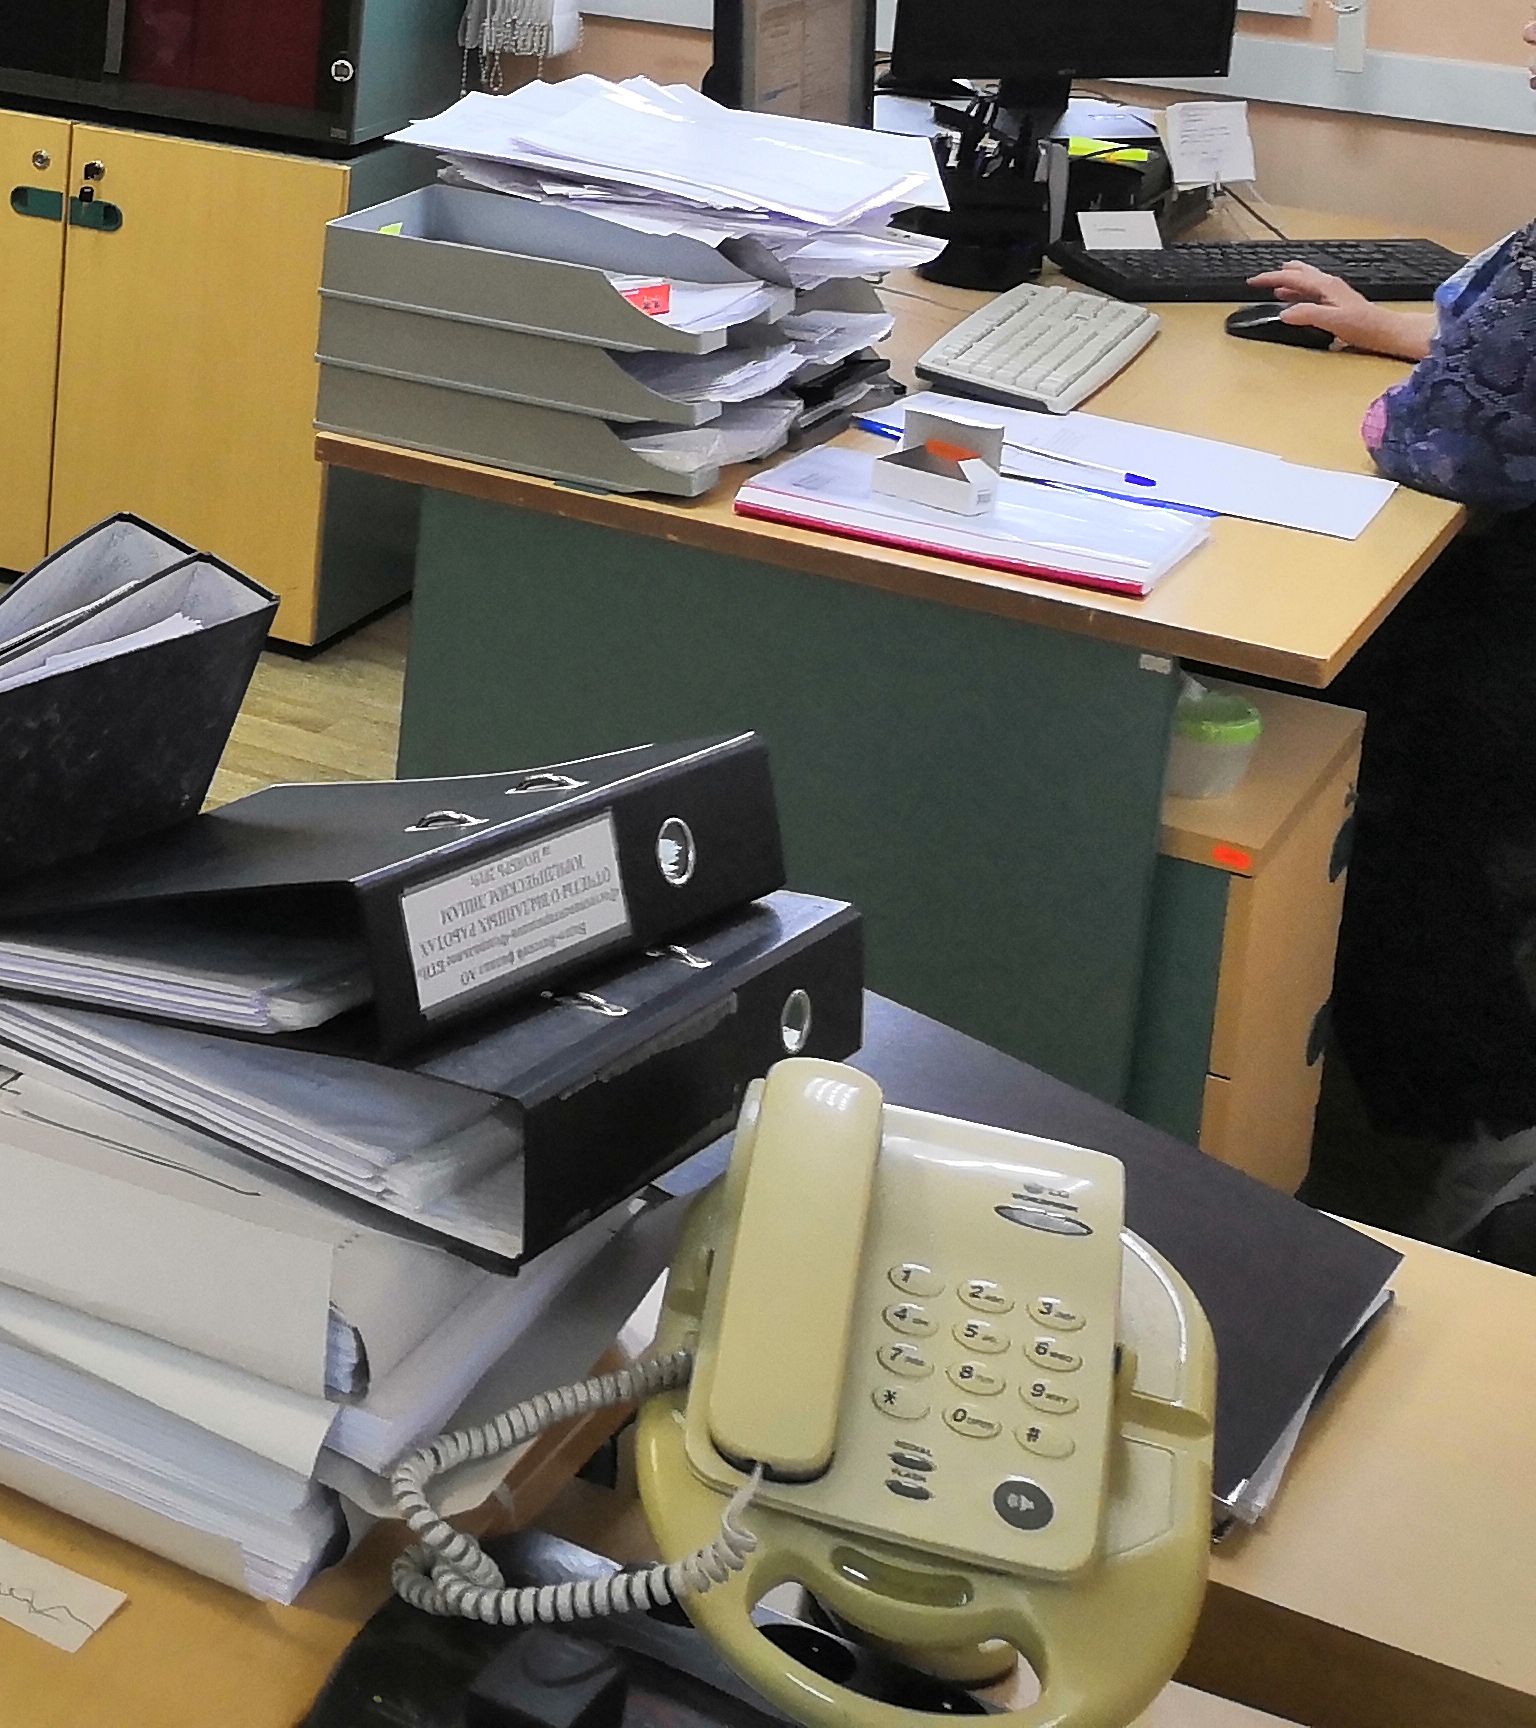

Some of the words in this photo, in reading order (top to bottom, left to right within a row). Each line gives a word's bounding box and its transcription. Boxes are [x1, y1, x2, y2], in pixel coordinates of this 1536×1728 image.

[488, 853, 585, 905] ЮРИДИЧЕСКИМ
[438, 891, 488, 925] ЛИЦАМ
[477, 891, 549, 934] ВЫДАННЫХ
[418, 921, 476, 958] РАБОТАХ
[901, 1270, 912, 1284] 1
[969, 1285, 984, 1300] 2
[1038, 1301, 1054, 1316] 3
[893, 1308, 908, 1321] 4
[964, 1324, 979, 1339] 5
[1035, 1341, 1049, 1356] 6
[889, 1346, 903, 1361] 7
[959, 1365, 975, 1380] 8
[1031, 1383, 1046, 1398] 9
[952, 1408, 968, 1423] 0
